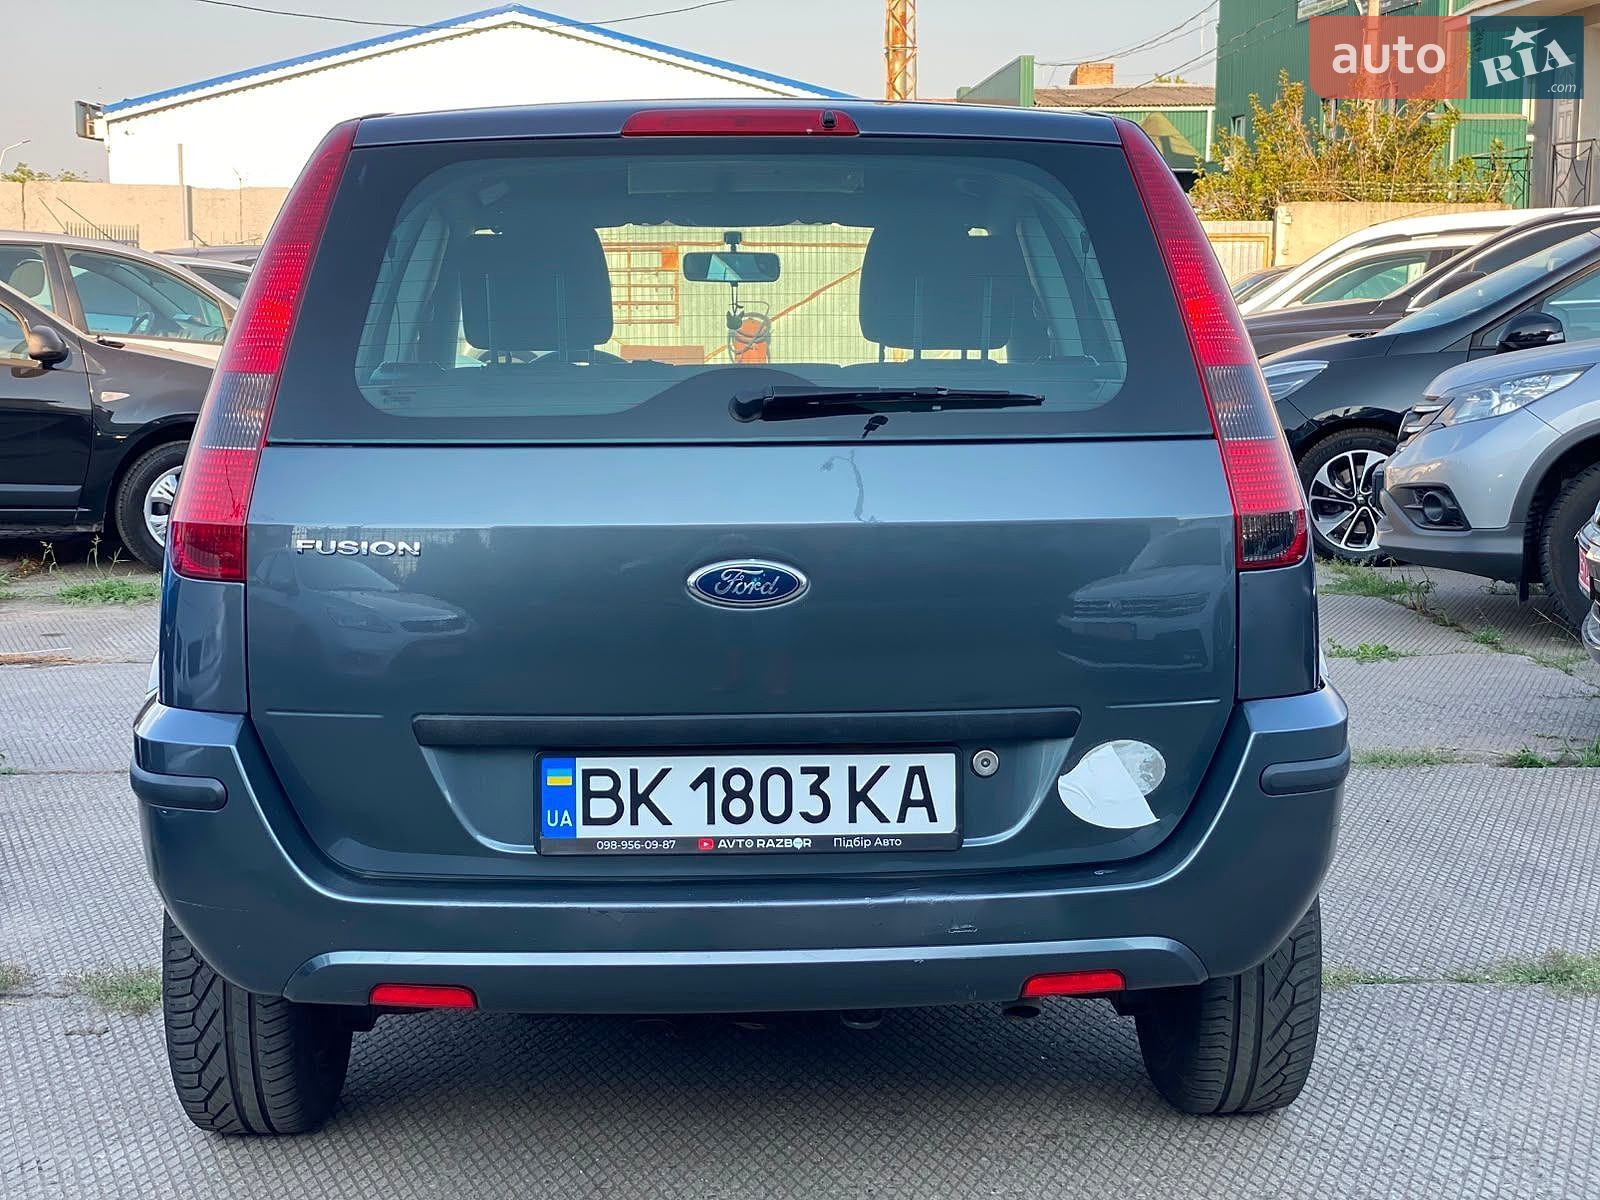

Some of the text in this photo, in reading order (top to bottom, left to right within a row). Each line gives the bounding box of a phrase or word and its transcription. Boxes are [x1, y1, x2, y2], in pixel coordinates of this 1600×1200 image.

[296, 539, 421, 556] FUSION
[714, 568, 780, 595] Ford
[581, 764, 939, 826] BK 1803 KA
[546, 808, 573, 827] UA
[596, 839, 676, 850] 098-956-09-87
[717, 838, 812, 849] AVTO RAZBOR
[833, 836, 902, 849] Підбір Авто
